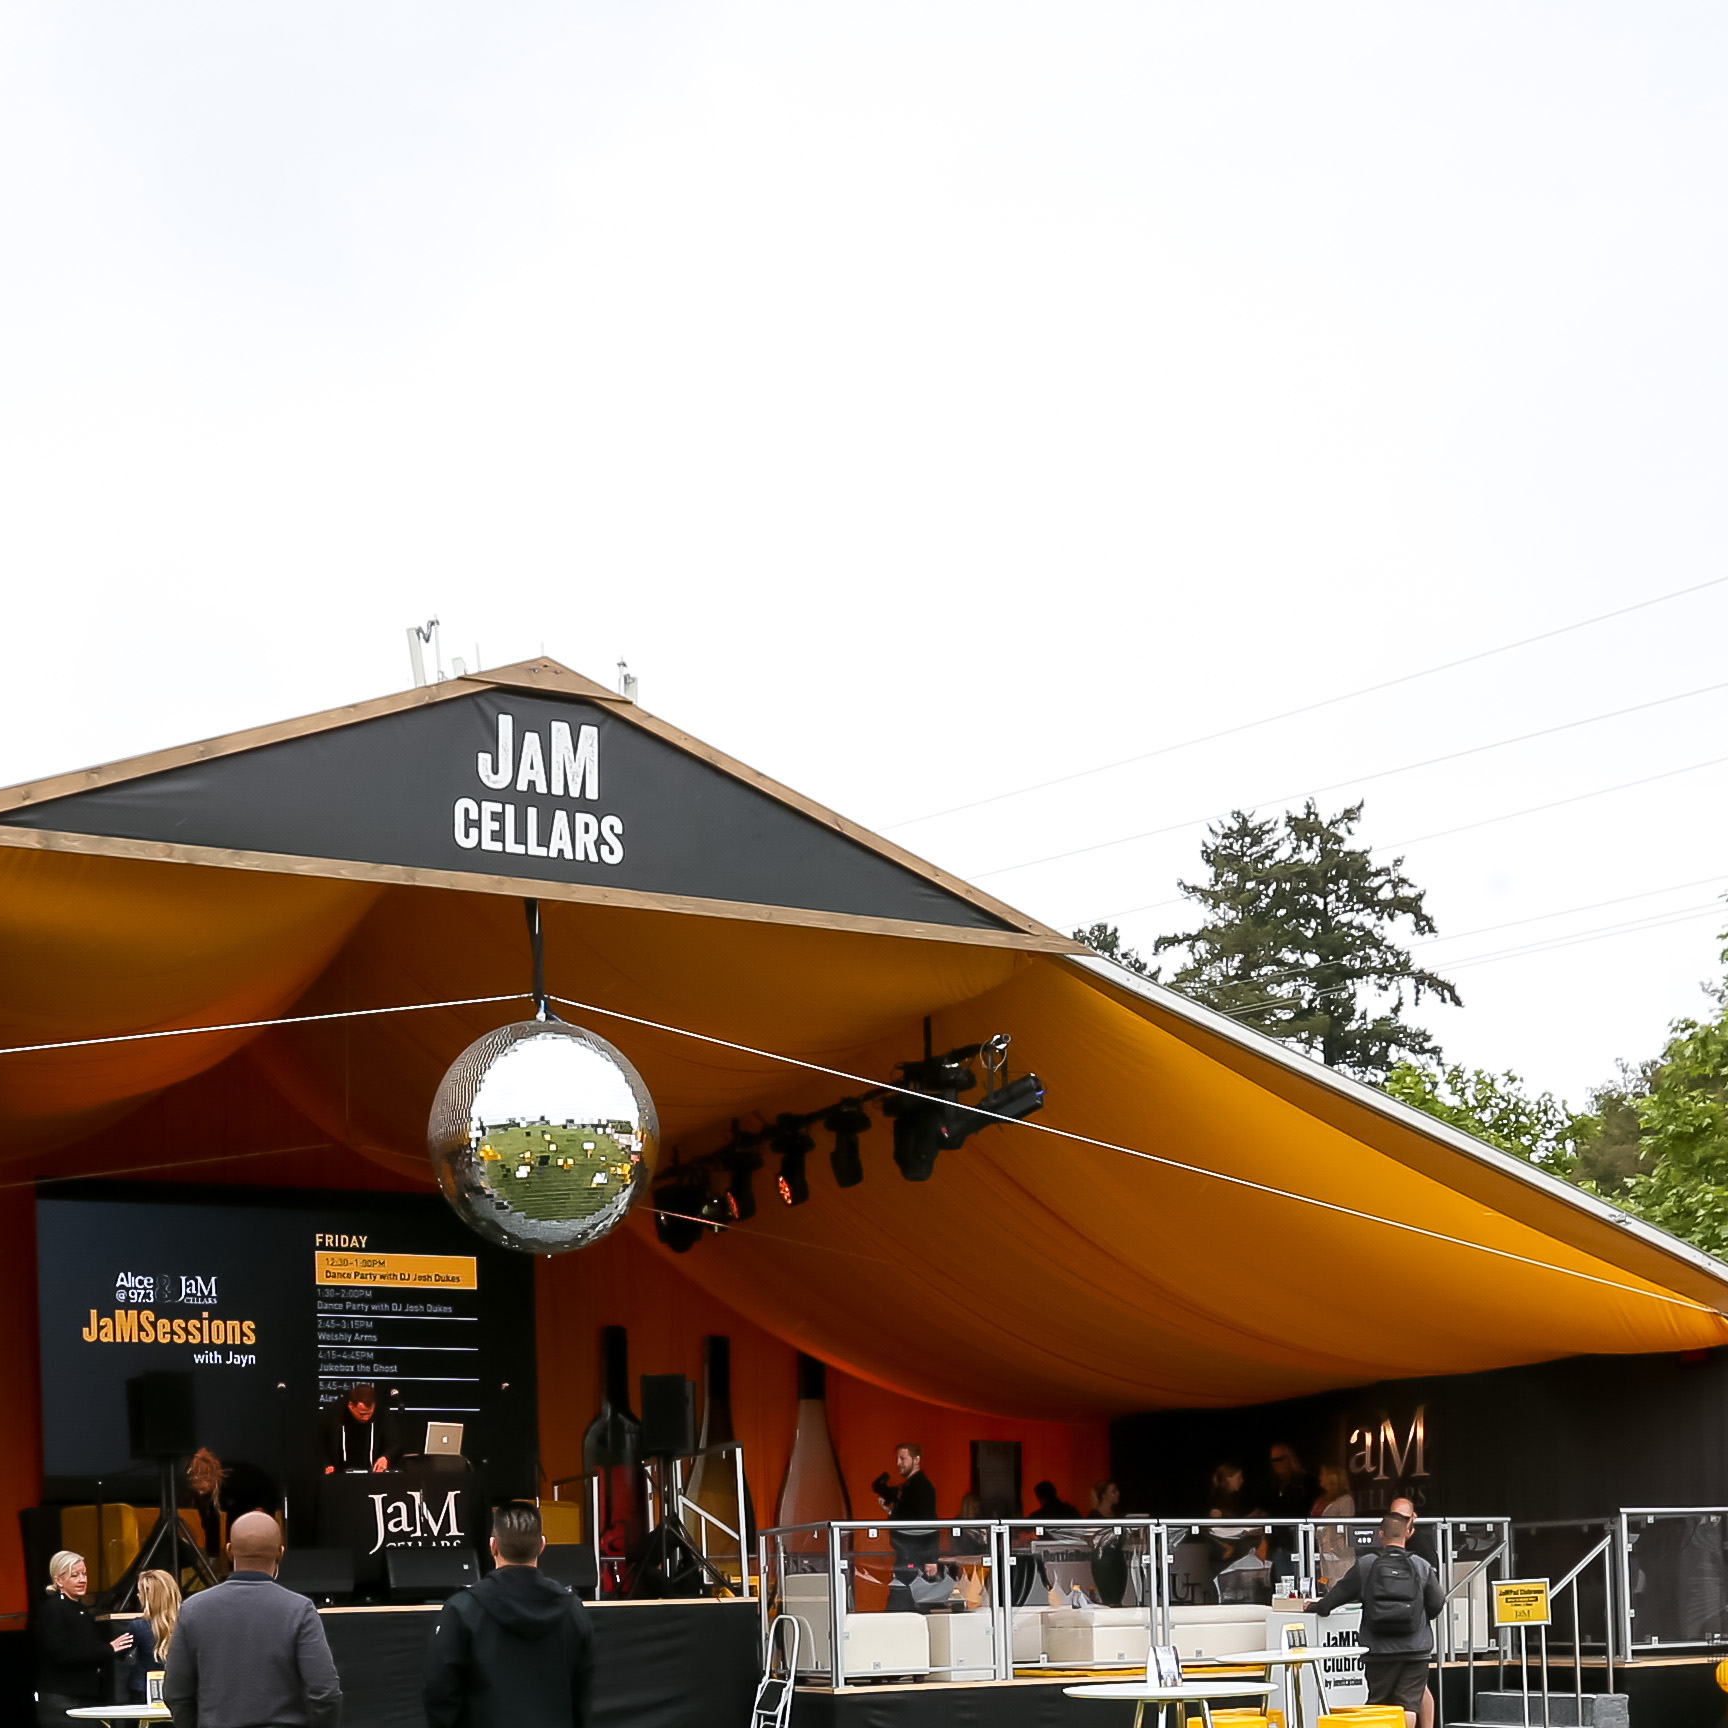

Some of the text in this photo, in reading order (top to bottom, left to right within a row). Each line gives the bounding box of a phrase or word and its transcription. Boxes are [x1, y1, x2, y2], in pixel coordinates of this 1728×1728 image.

[454, 797, 624, 865] CELLARS
[315, 1233, 368, 1248] FRIDAY
[115, 1271, 154, 1289] Alice
[325, 1269, 460, 1283] Dance Party with DJ Josh Dukes
[115, 1289, 154, 1303] @ 97.3
[176, 1275, 218, 1302] JaM
[183, 1296, 218, 1304] CELLARS
[317, 1301, 452, 1313] Dance Party with DJ Josh Dukes
[82, 1309, 256, 1345] JaMSessions
[354, 1333, 377, 1342] Arms
[193, 1351, 256, 1367] with Jayn
[318, 1363, 398, 1373] Jukebox the Ghost
[368, 1490, 465, 1555] JaM
[1323, 1631, 1359, 1647] JaMP
[1325, 1679, 1332, 1689] by
